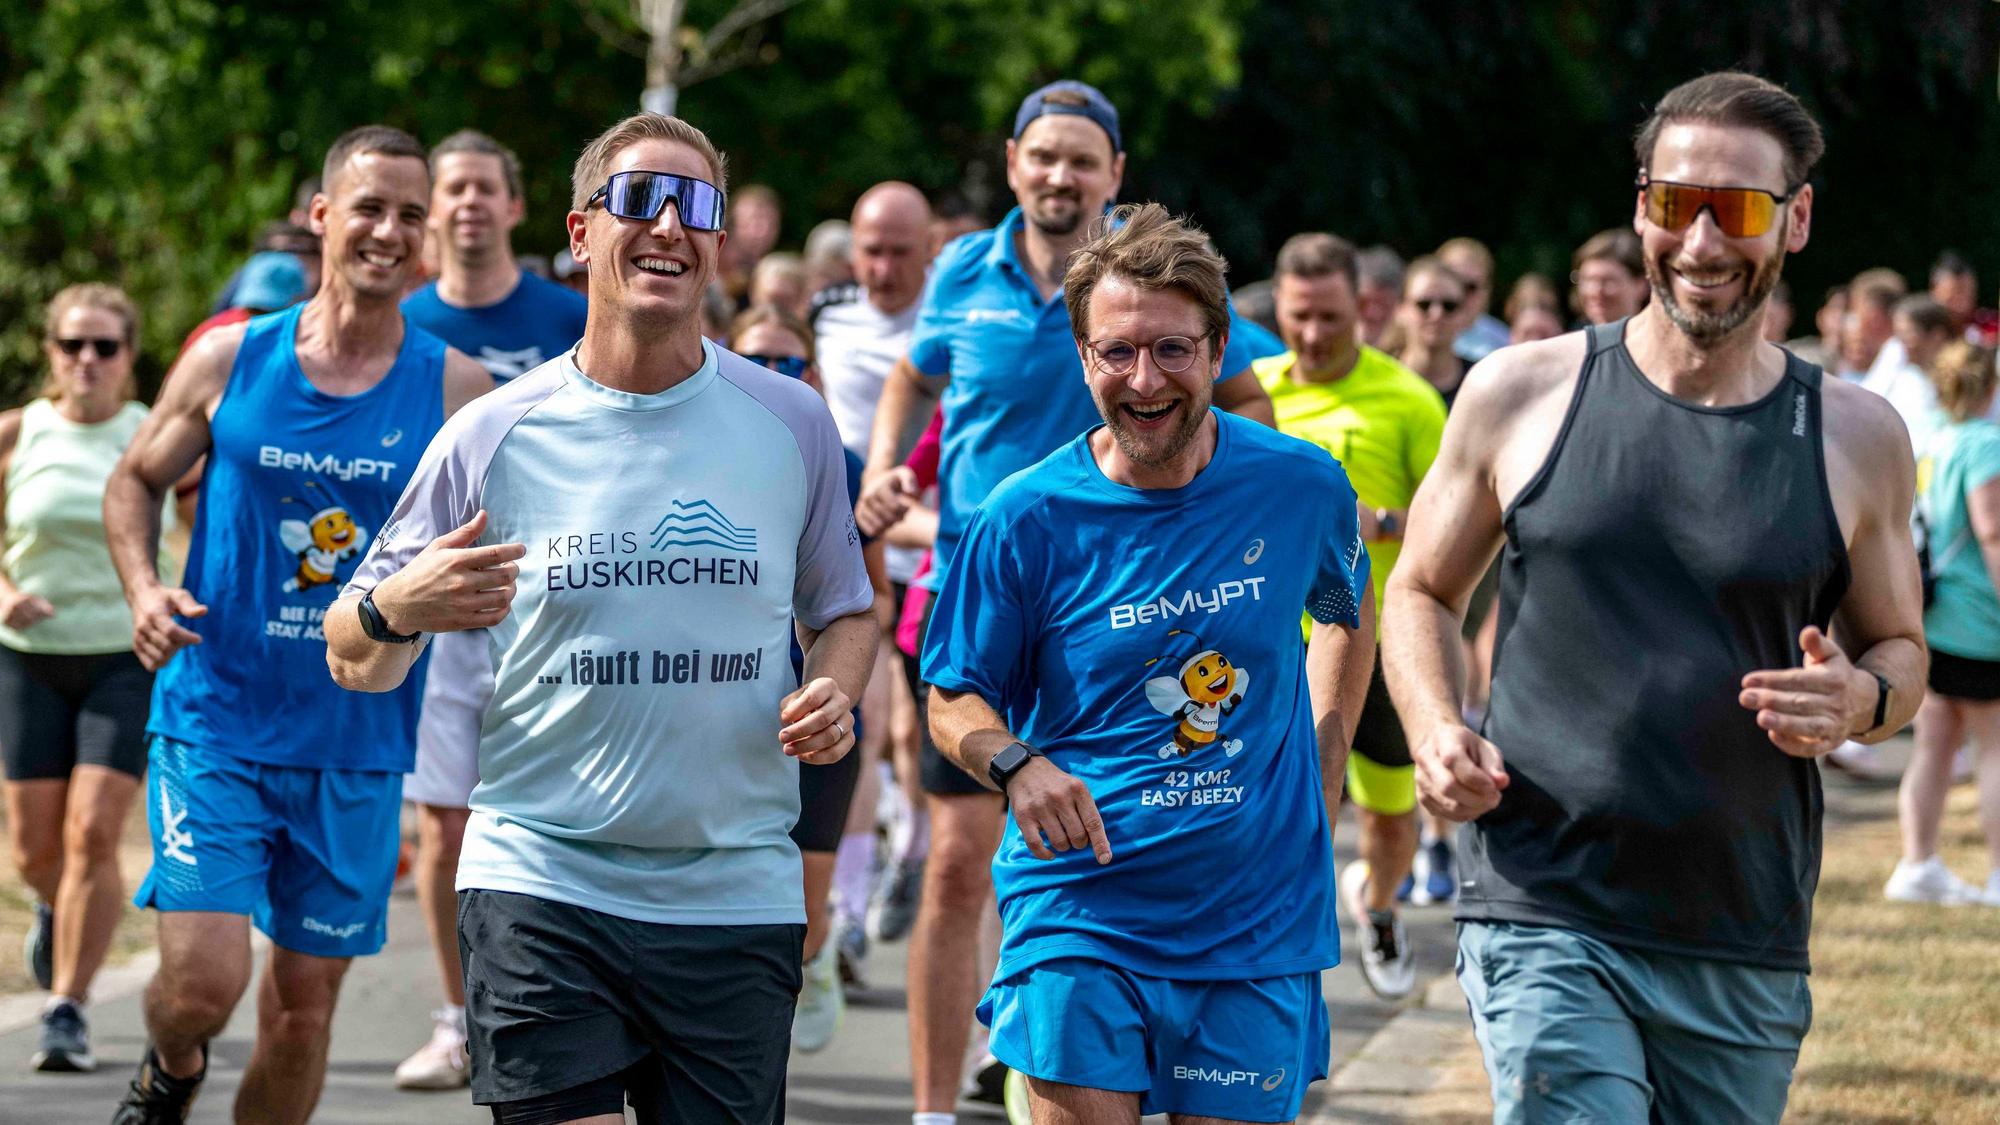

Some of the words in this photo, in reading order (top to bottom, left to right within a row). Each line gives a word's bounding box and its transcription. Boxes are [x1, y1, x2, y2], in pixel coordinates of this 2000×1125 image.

[1792, 394, 1806, 437] Reebok
[259, 446, 396, 482] BeMyPT
[548, 531, 638, 559] KREIS
[547, 557, 759, 592] EUSKIRCHEN
[280, 605, 305, 622] BEE
[1109, 576, 1266, 630] BeMyPT
[265, 620, 302, 640] STAY
[570, 649, 640, 686] läuft
[652, 648, 700, 684] bei
[710, 647, 763, 683] uns!
[1163, 770, 1189, 788] 42
[1193, 769, 1231, 786] KM?
[1141, 789, 1189, 807] EASY
[1191, 786, 1244, 807] BEEZY
[1173, 1065, 1260, 1086] BeMyPT
